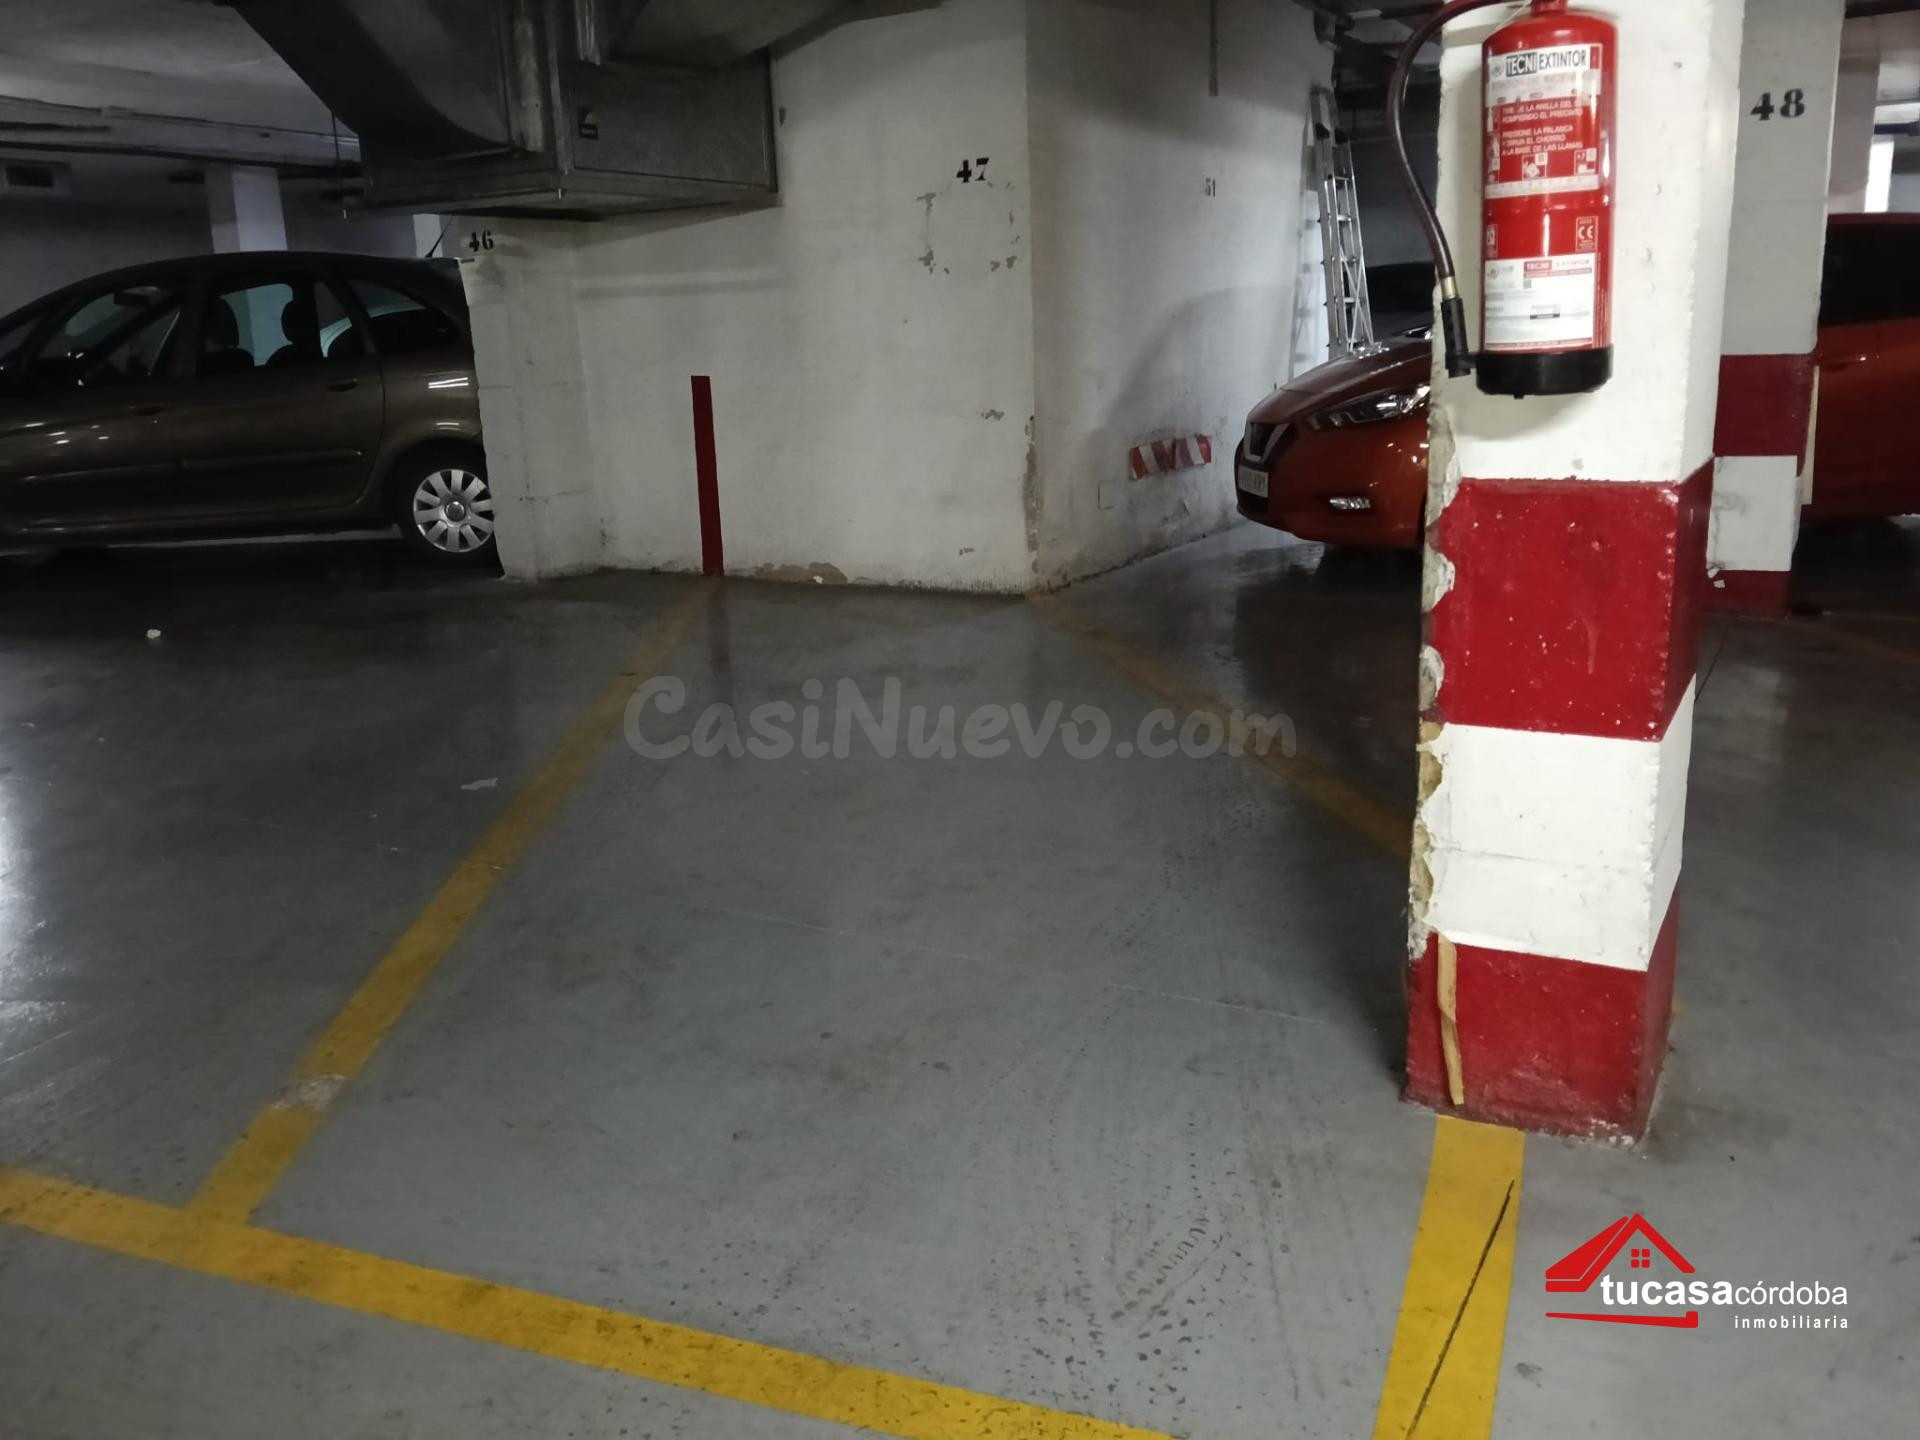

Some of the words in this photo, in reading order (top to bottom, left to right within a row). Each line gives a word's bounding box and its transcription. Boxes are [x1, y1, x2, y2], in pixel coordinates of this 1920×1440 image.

[1506, 52, 1537, 77] TECNI
[1539, 50, 1586, 70] EXTINTOR
[1750, 88, 1805, 121] 48
[956, 157, 990, 184] 47
[469, 230, 494, 252] 46
